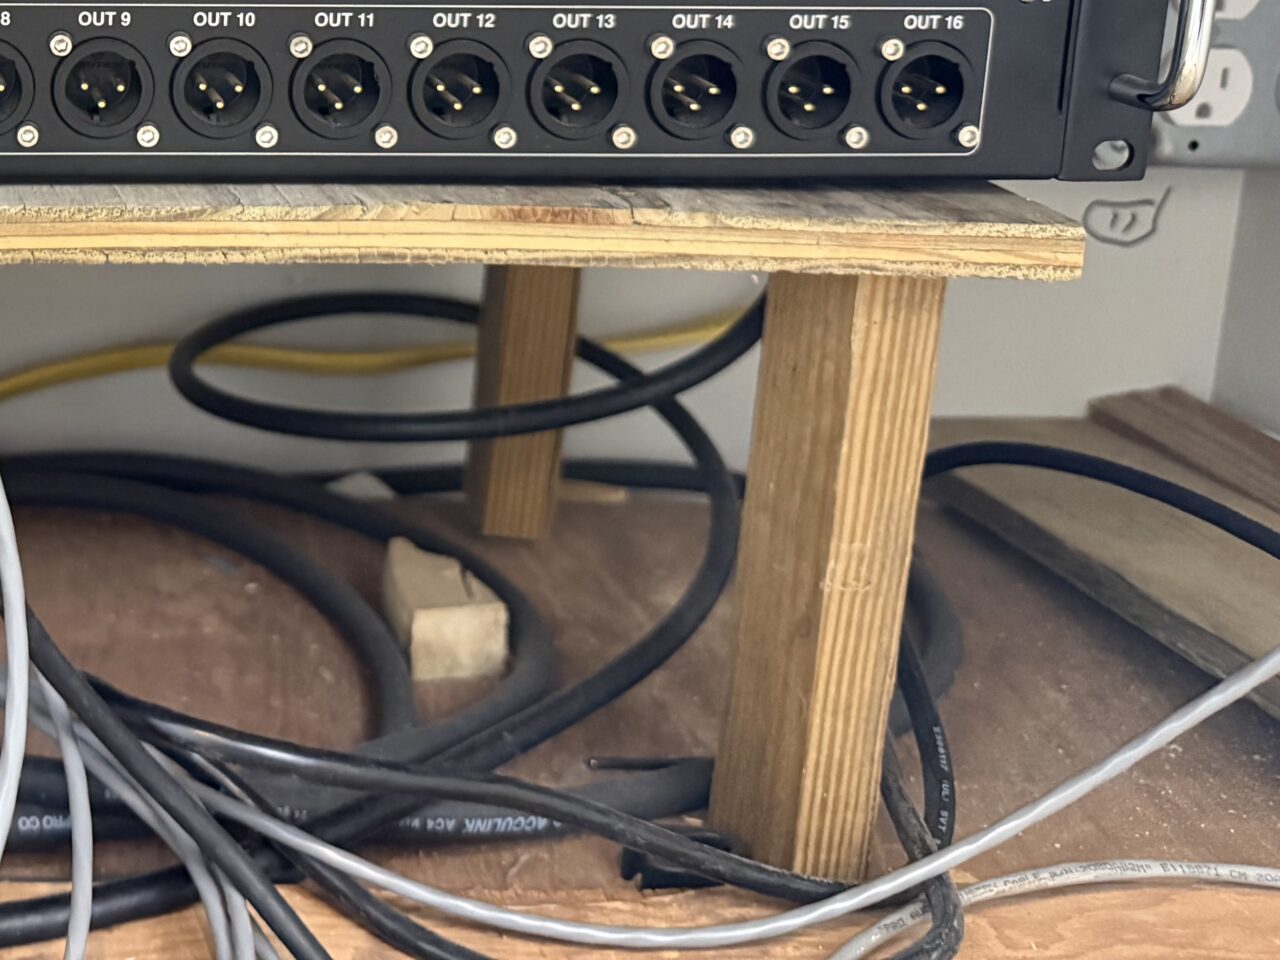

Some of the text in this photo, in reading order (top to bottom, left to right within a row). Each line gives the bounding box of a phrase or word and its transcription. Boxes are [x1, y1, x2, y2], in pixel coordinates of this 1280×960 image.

[0, 10, 11, 26] 8
[78, 10, 132, 27] OUT 9
[193, 11, 256, 27] OUT 10
[314, 11, 374, 28] OUT 11
[432, 12, 496, 28] OUT 12
[552, 12, 616, 29] OUT 13
[671, 13, 734, 29] OUT 14
[789, 14, 850, 30] OUT 15
[903, 14, 964, 30] OUT 16
